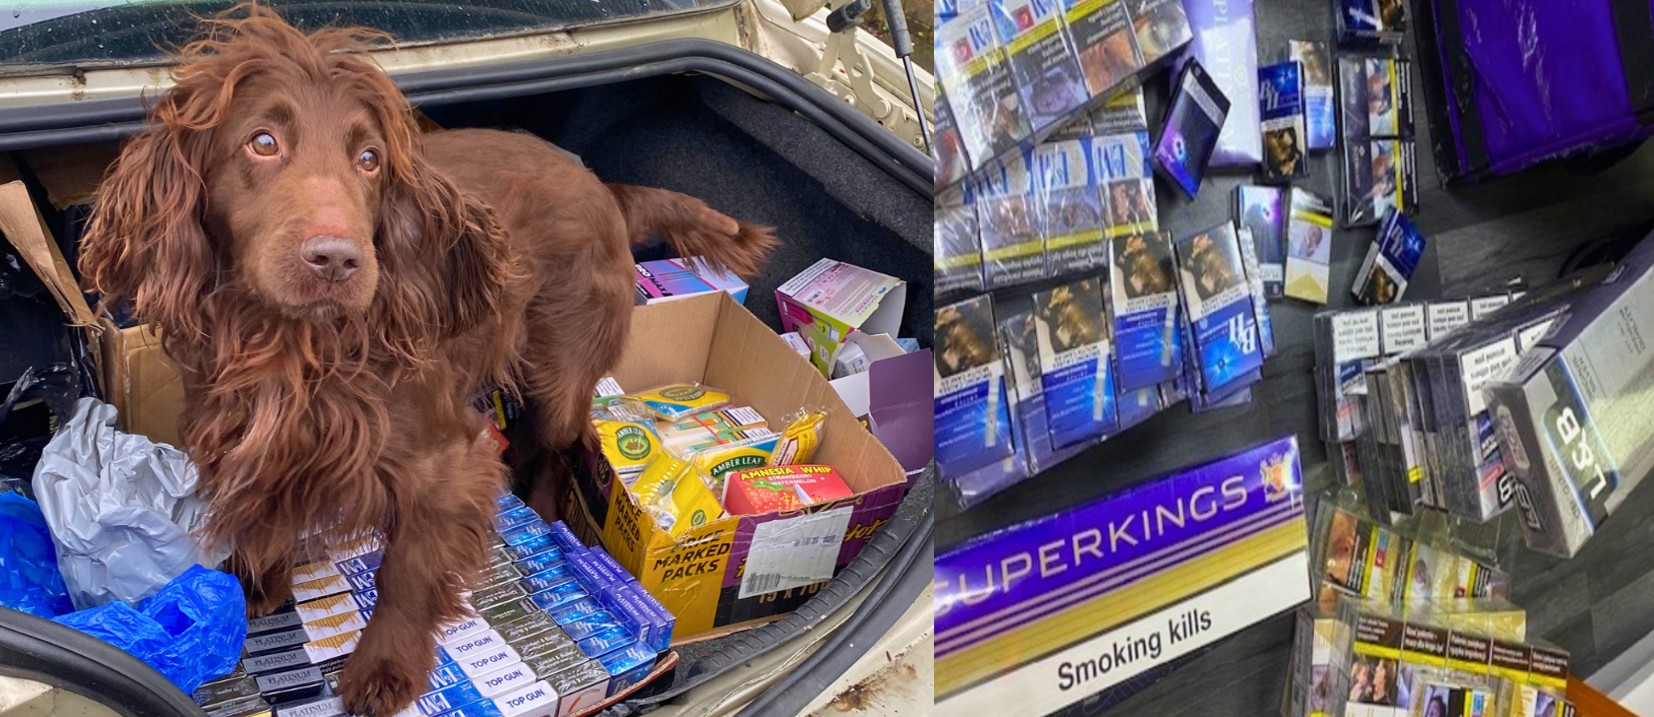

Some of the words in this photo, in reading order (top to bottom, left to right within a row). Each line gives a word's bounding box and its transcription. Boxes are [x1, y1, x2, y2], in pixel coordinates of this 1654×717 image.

[1556, 406, 1607, 499] L&B
[712, 457, 741, 476] AMBER
[741, 456, 762, 467] LEAF
[740, 466, 795, 481] AMNESIA
[800, 465, 832, 475] WHIP
[767, 473, 813, 482] STRAWBERRY
[770, 477, 818, 487] WATERMELON
[614, 496, 640, 542] MARKED
[614, 515, 636, 553] PACKS
[653, 542, 732, 571] MARKED
[661, 558, 720, 584] PACKS
[459, 620, 478, 632] GUN
[254, 632, 297, 646] PLATINUM
[455, 642, 475, 653] TOP
[474, 636, 493, 647] GUN
[1057, 630, 1162, 692] Smoking
[1169, 608, 1212, 646] kills
[254, 652, 298, 666] PLATINUM
[470, 658, 489, 669] TOP
[489, 652, 508, 663] GUN
[268, 670, 312, 684] PLATINUM
[485, 676, 504, 689] TOP
[503, 670, 524, 682] GUN
[506, 697, 526, 708] TOP
[525, 689, 545, 702] GUN
[289, 702, 333, 717] PLATINUM
